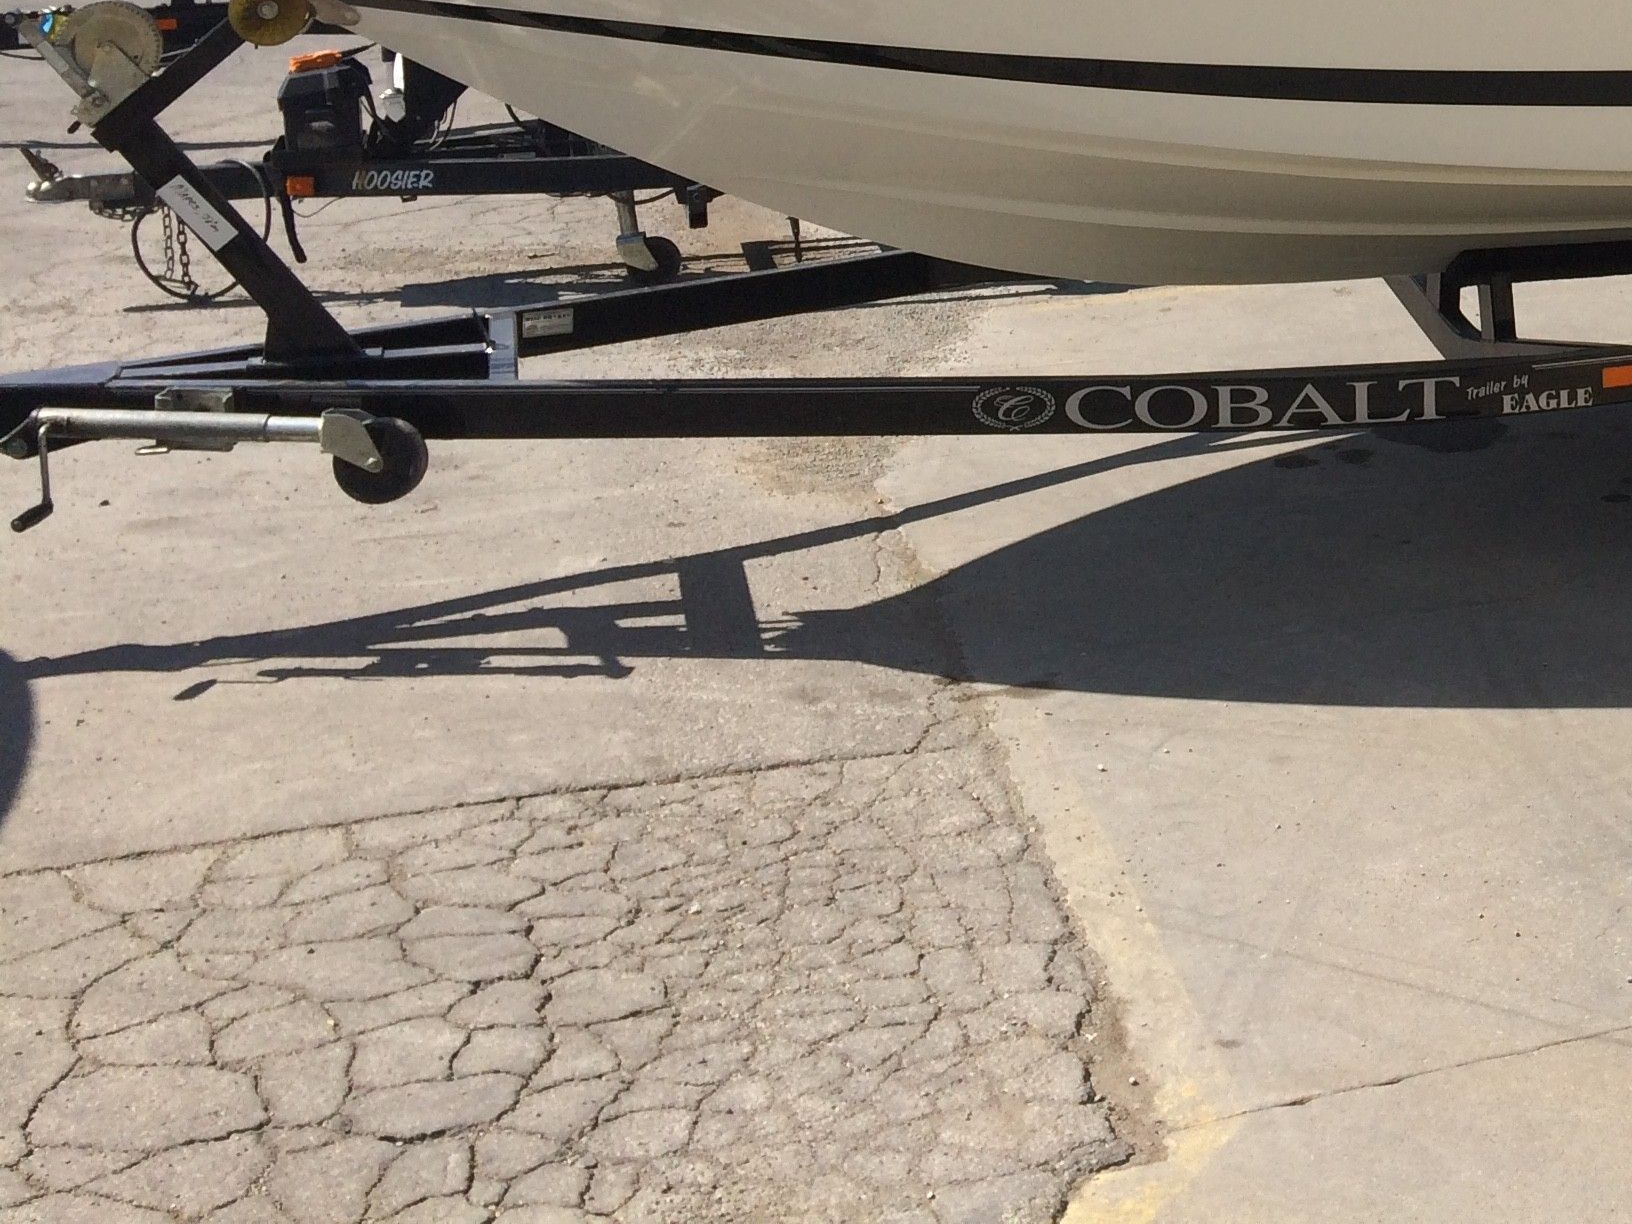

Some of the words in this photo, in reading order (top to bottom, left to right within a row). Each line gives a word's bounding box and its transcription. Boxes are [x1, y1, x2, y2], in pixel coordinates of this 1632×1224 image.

[352, 169, 434, 190] HOOSIER
[1466, 380, 1507, 401] Trailer
[1513, 374, 1530, 389] by
[1501, 386, 1594, 415] EAGLE
[1064, 376, 1460, 431] COBALT
